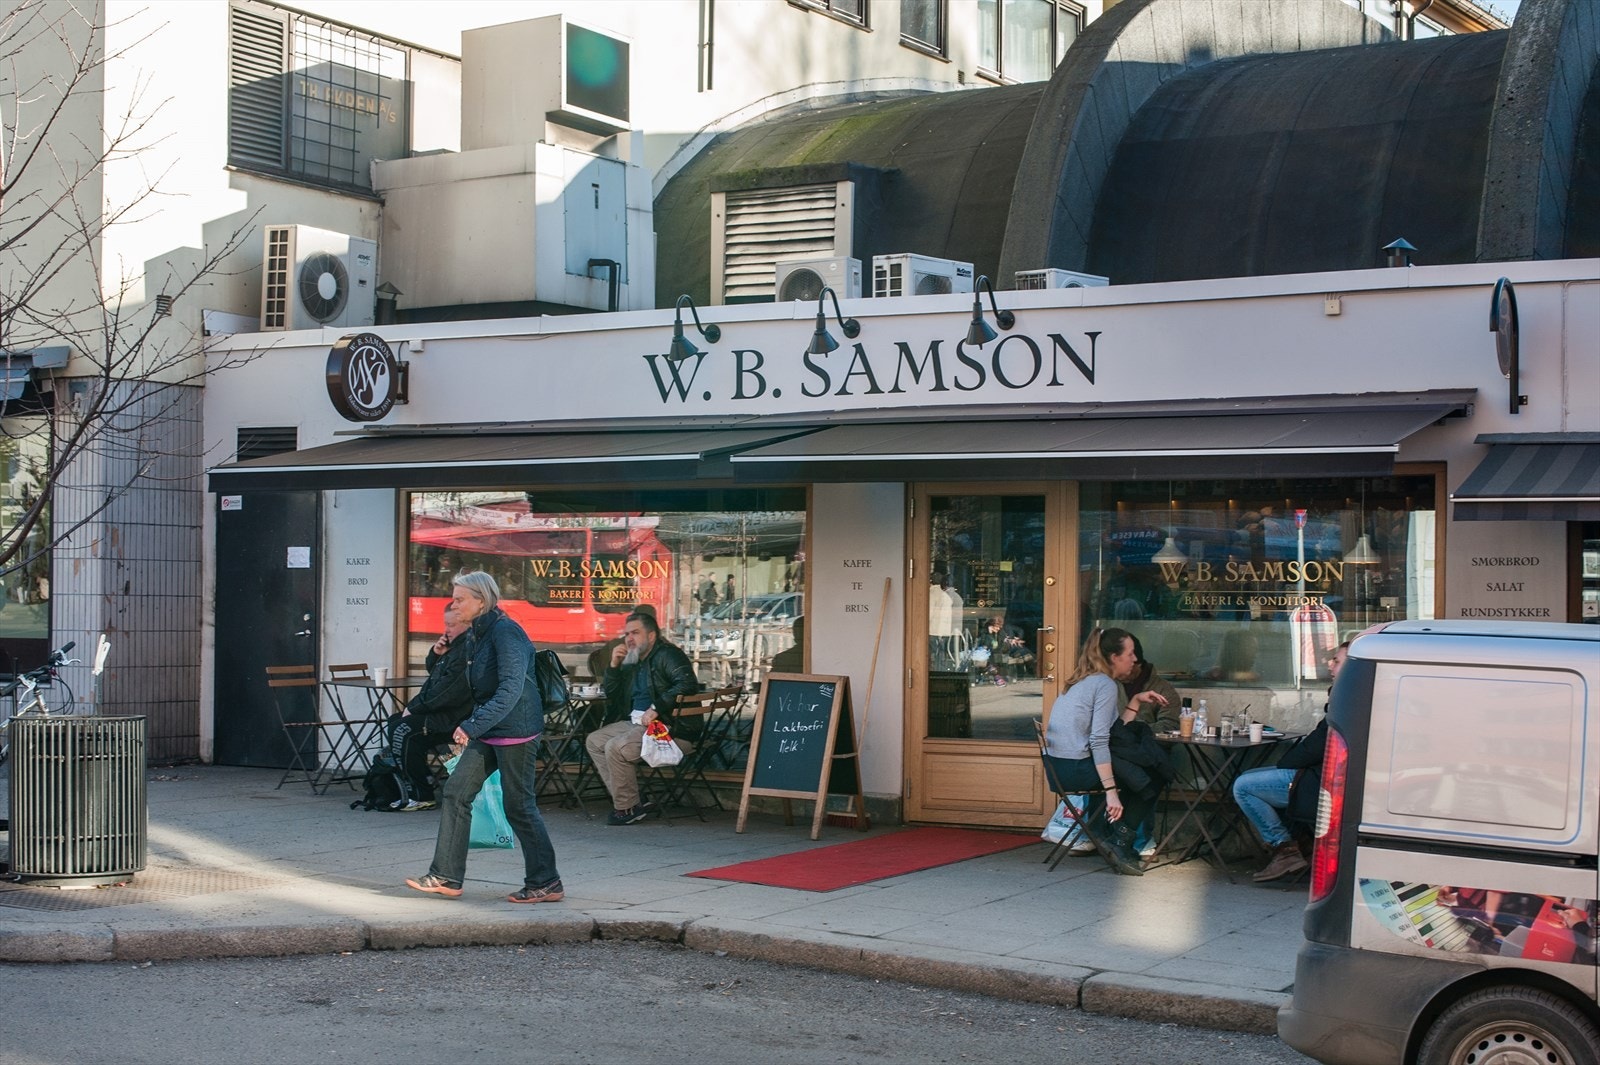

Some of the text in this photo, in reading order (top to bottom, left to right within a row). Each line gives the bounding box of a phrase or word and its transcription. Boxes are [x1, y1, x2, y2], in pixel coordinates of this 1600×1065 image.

[380, 102, 397, 123] A/S
[364, 336, 391, 358] SAMSON
[642, 331, 1103, 404] W. B. SAMSON
[346, 557, 371, 566] KAKER
[843, 559, 872, 568] KAFFE
[1471, 557, 1540, 567] SMØRBRØD
[530, 559, 671, 579] W. B. SAMSON
[1157, 560, 1345, 583] W. B. SAMSON
[347, 577, 369, 586] BRØD
[851, 581, 863, 590] TE
[1486, 582, 1525, 592] SALAT
[550, 589, 654, 600] BAKERI & KONDITORI
[346, 597, 370, 606] BAKST
[1184, 595, 1324, 606] BAKERI & KONDITORI
[845, 604, 870, 613] BRUS
[1461, 607, 1551, 618] RUNDSTYKKER
[779, 692, 820, 712] Vi har
[773, 720, 824, 733] Laktosefri
[779, 737, 806, 754] Melk!
